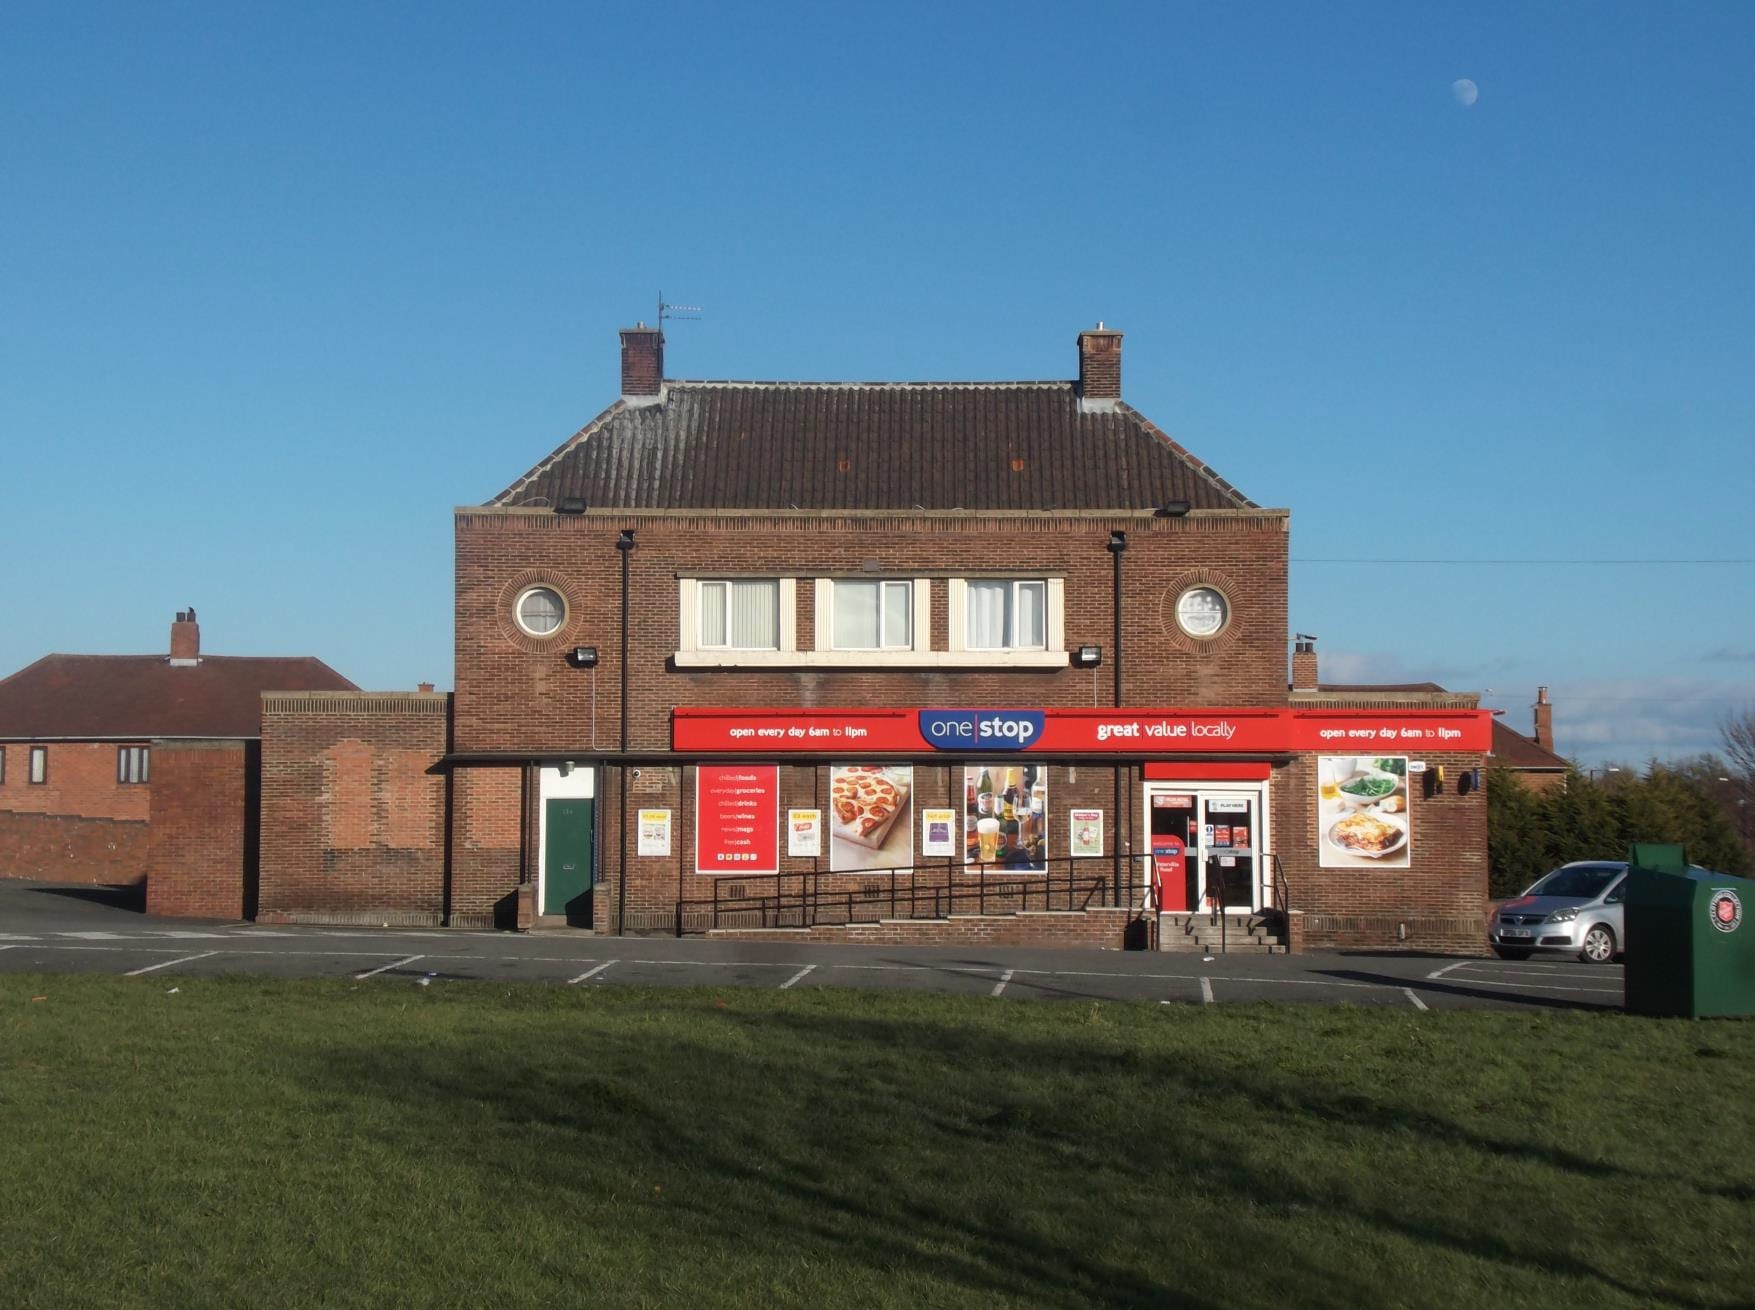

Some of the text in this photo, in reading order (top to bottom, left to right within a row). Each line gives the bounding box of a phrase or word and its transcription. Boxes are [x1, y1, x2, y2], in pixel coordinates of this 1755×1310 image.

[729, 727, 755, 738] open
[758, 727, 785, 738] every
[788, 726, 806, 738] day
[808, 726, 830, 737] 6am
[832, 727, 842, 737] to
[931, 716, 1034, 743] one stop
[1096, 720, 1236, 740] great value locally
[1320, 728, 1345, 739] open
[1348, 728, 1376, 739] every
[1379, 727, 1397, 739] day
[1400, 727, 1422, 738] 6am
[1425, 728, 1435, 738] to
